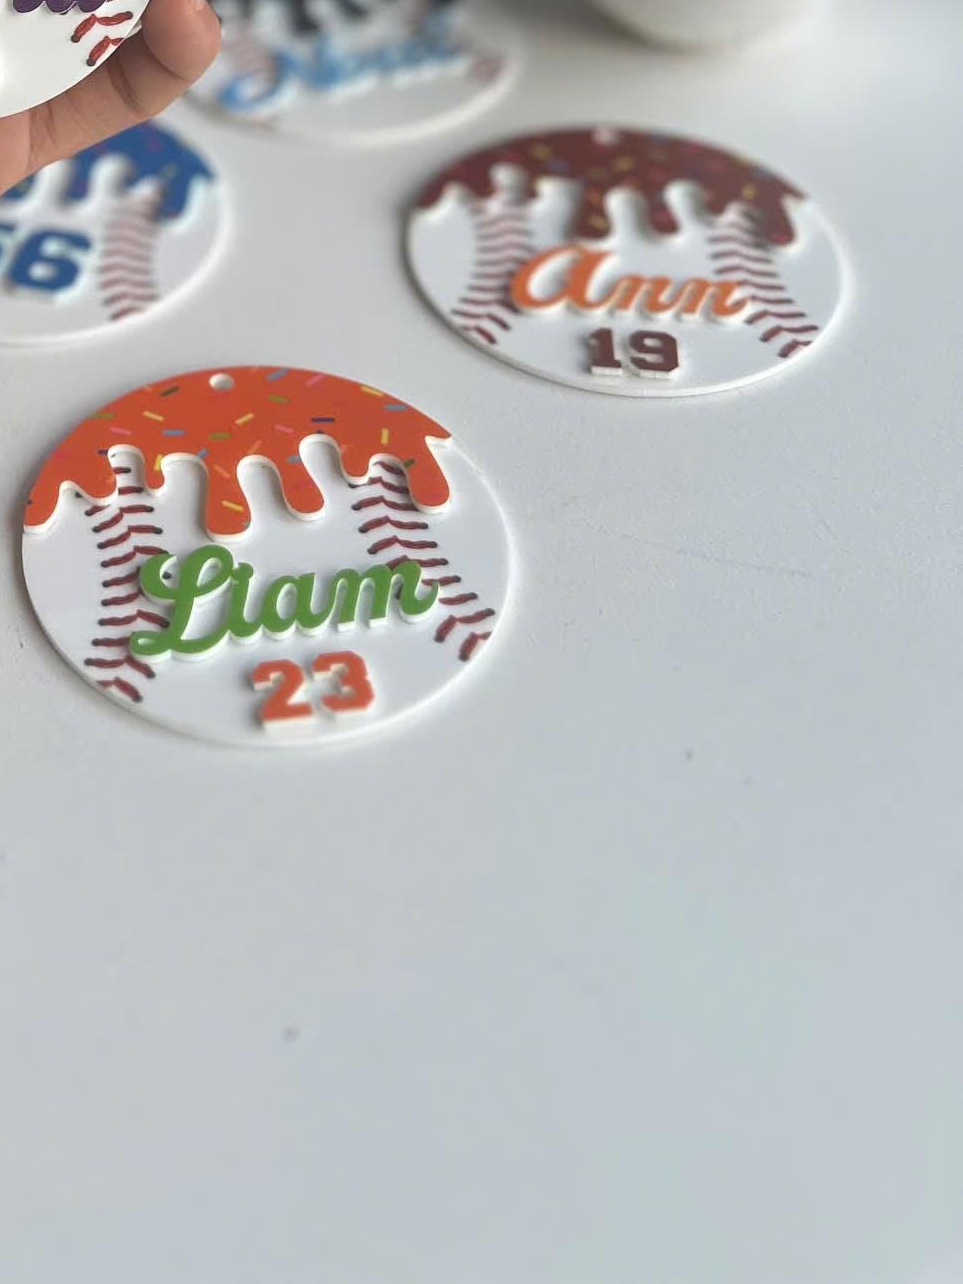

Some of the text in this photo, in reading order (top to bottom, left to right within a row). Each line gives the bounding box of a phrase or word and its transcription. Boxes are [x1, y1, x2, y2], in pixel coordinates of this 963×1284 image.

[509, 244, 750, 317] Ann
[588, 327, 680, 374] 19
[129, 544, 438, 655] Liam
[251, 651, 375, 724] 23
